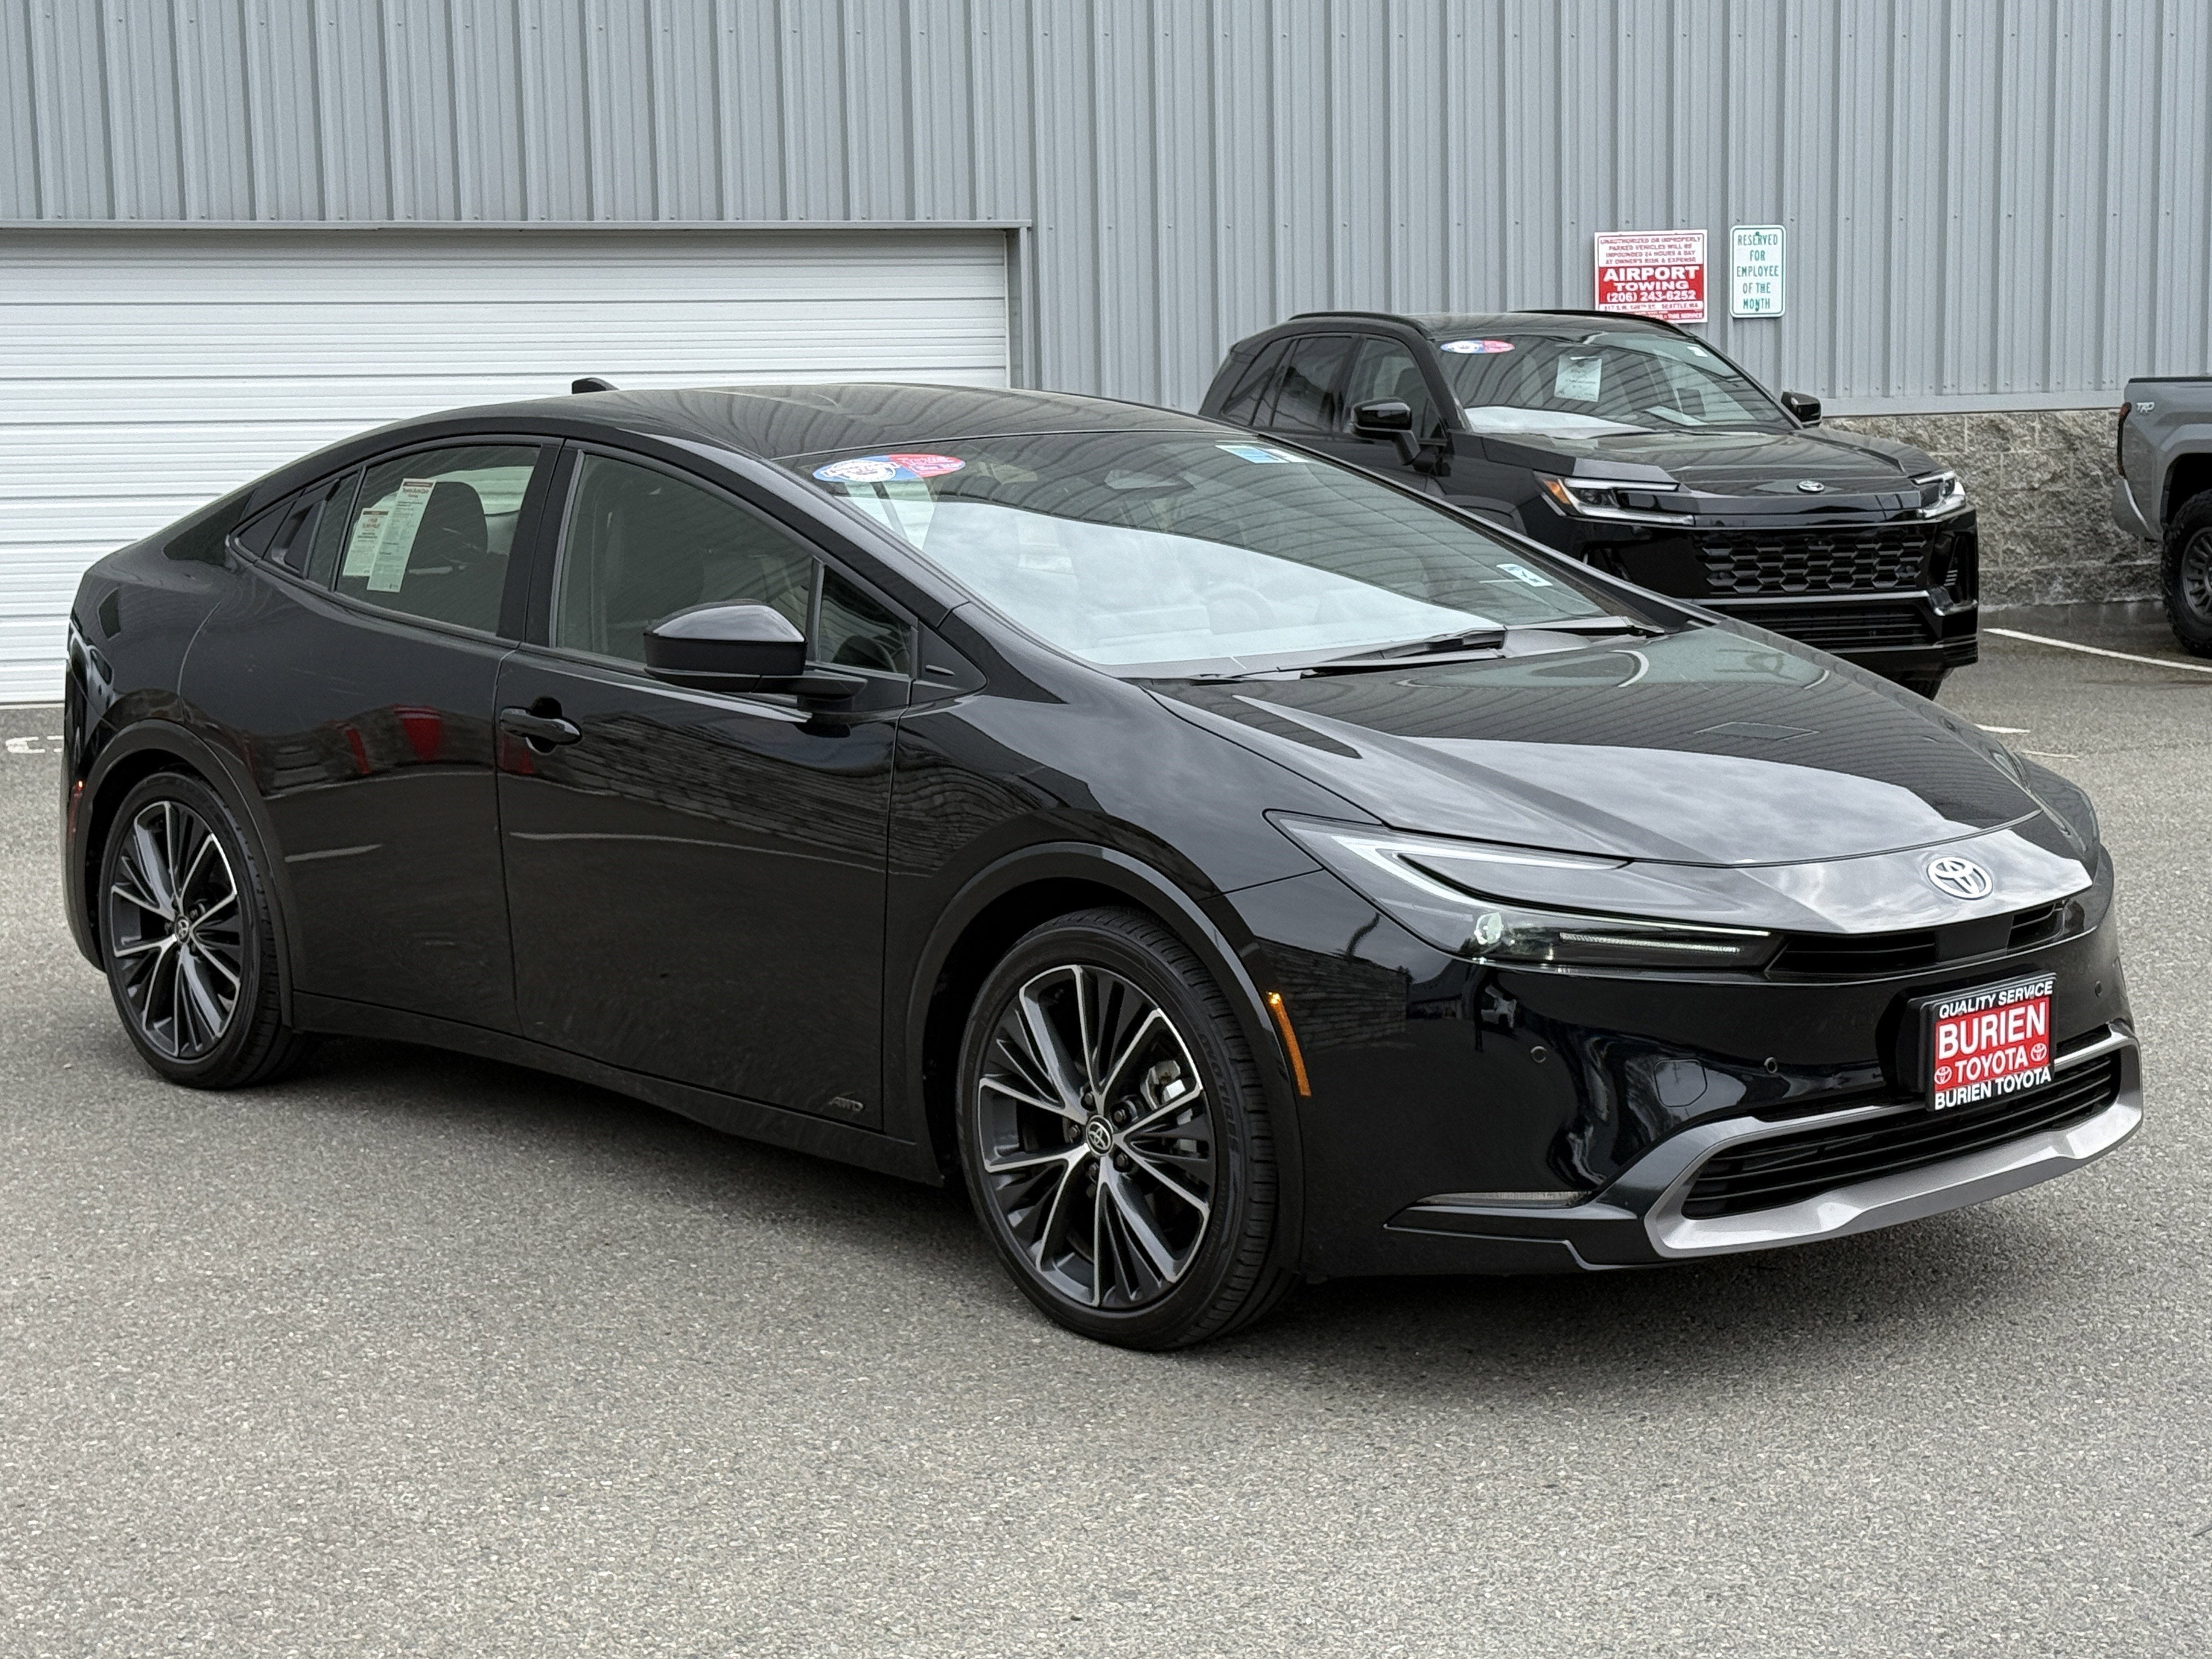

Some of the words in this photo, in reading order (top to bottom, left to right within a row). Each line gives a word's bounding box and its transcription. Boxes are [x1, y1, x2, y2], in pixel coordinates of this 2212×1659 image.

[1737, 234, 1778, 246] RESERVED
[1750, 250, 1765, 262] FOR
[1603, 266, 1700, 283] AIRPORT
[1736, 266, 1779, 277] EMPLOYEE
[1613, 280, 1690, 292] TOWING
[1742, 283, 1753, 294] OF
[1756, 282, 1771, 294] THE
[1606, 292, 1638, 302] (206)
[1743, 298, 1771, 310] MONTH
[2136, 402, 2155, 413] TRD
[1939, 994, 1997, 1019] QUALITY
[1998, 980, 2053, 1006] SERVICE
[1938, 1001, 2046, 1060] BURIEN
[1954, 1045, 2040, 1084] TOYOTA
[1934, 1080, 1991, 1110] BURIEN
[1995, 1066, 2052, 1096] TOYOTA
